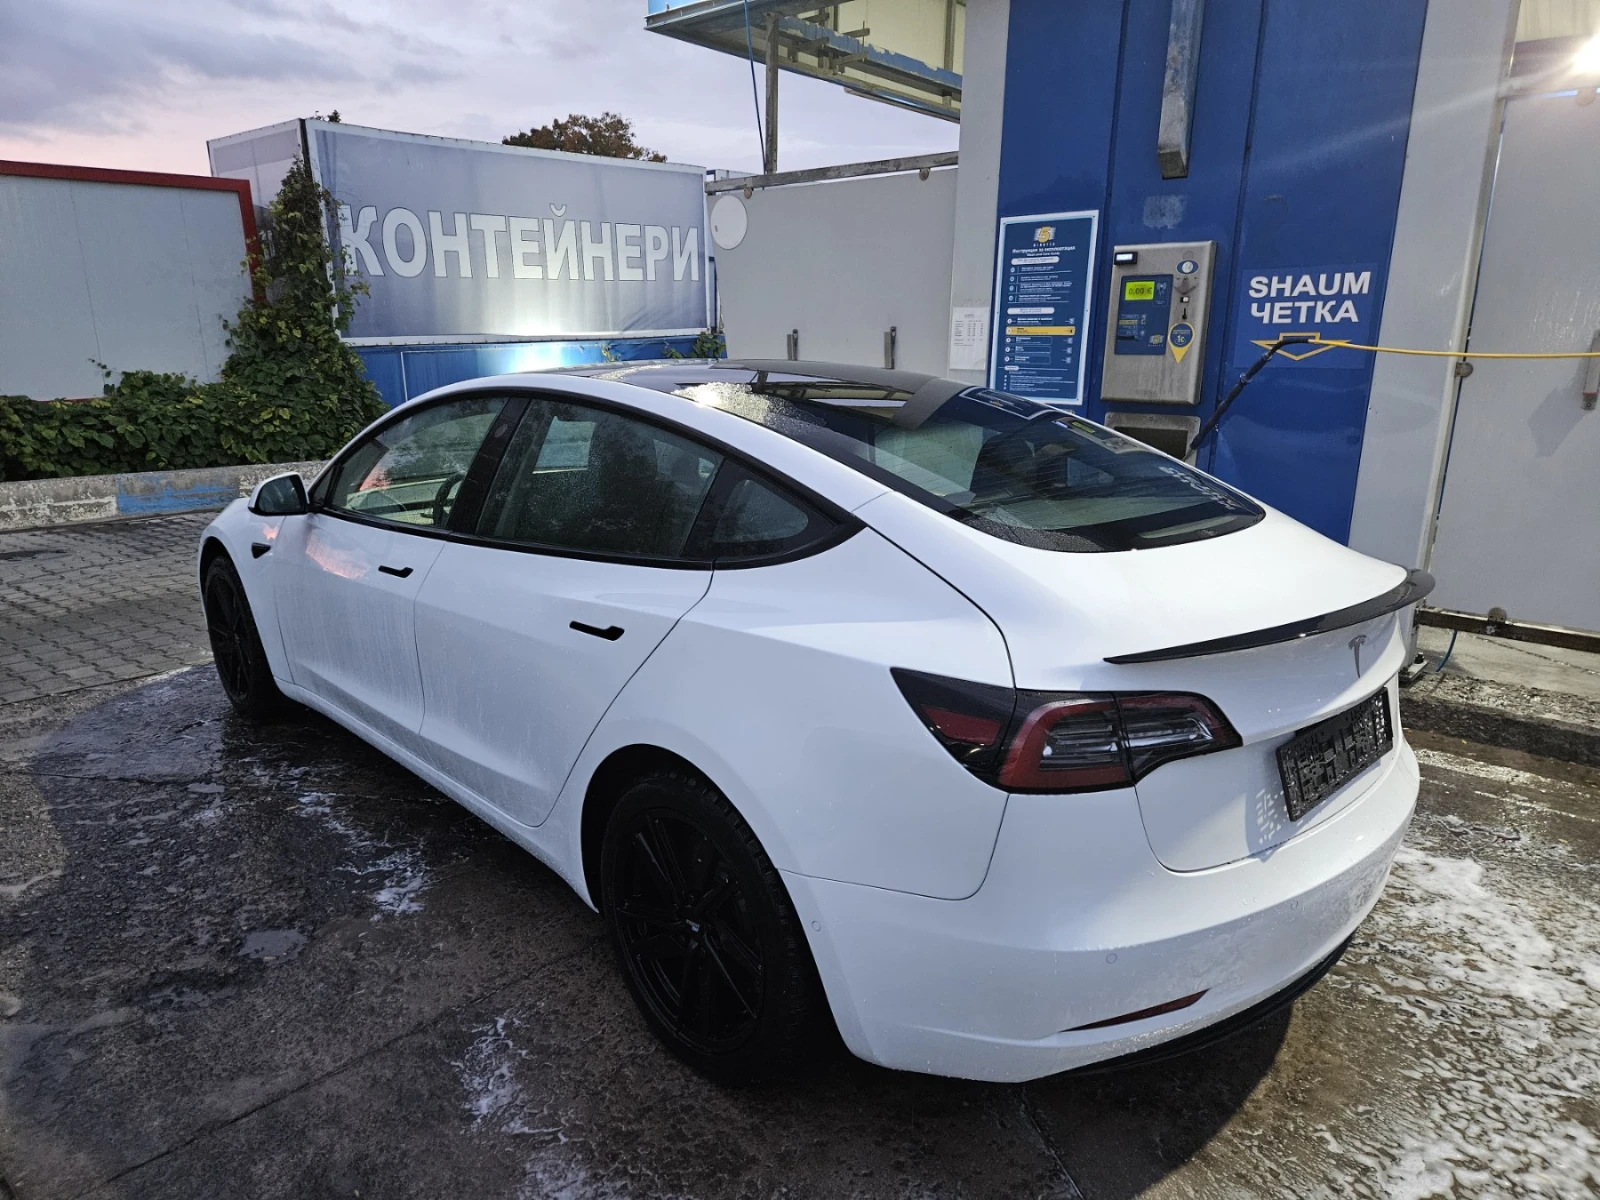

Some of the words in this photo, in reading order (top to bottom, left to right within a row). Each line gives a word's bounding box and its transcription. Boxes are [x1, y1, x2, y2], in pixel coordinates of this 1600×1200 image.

[338, 203, 700, 281] КОНТЕЙНЕРИ
[1249, 271, 1371, 298] SHAUM
[1251, 300, 1359, 324] ЧЕТКА
